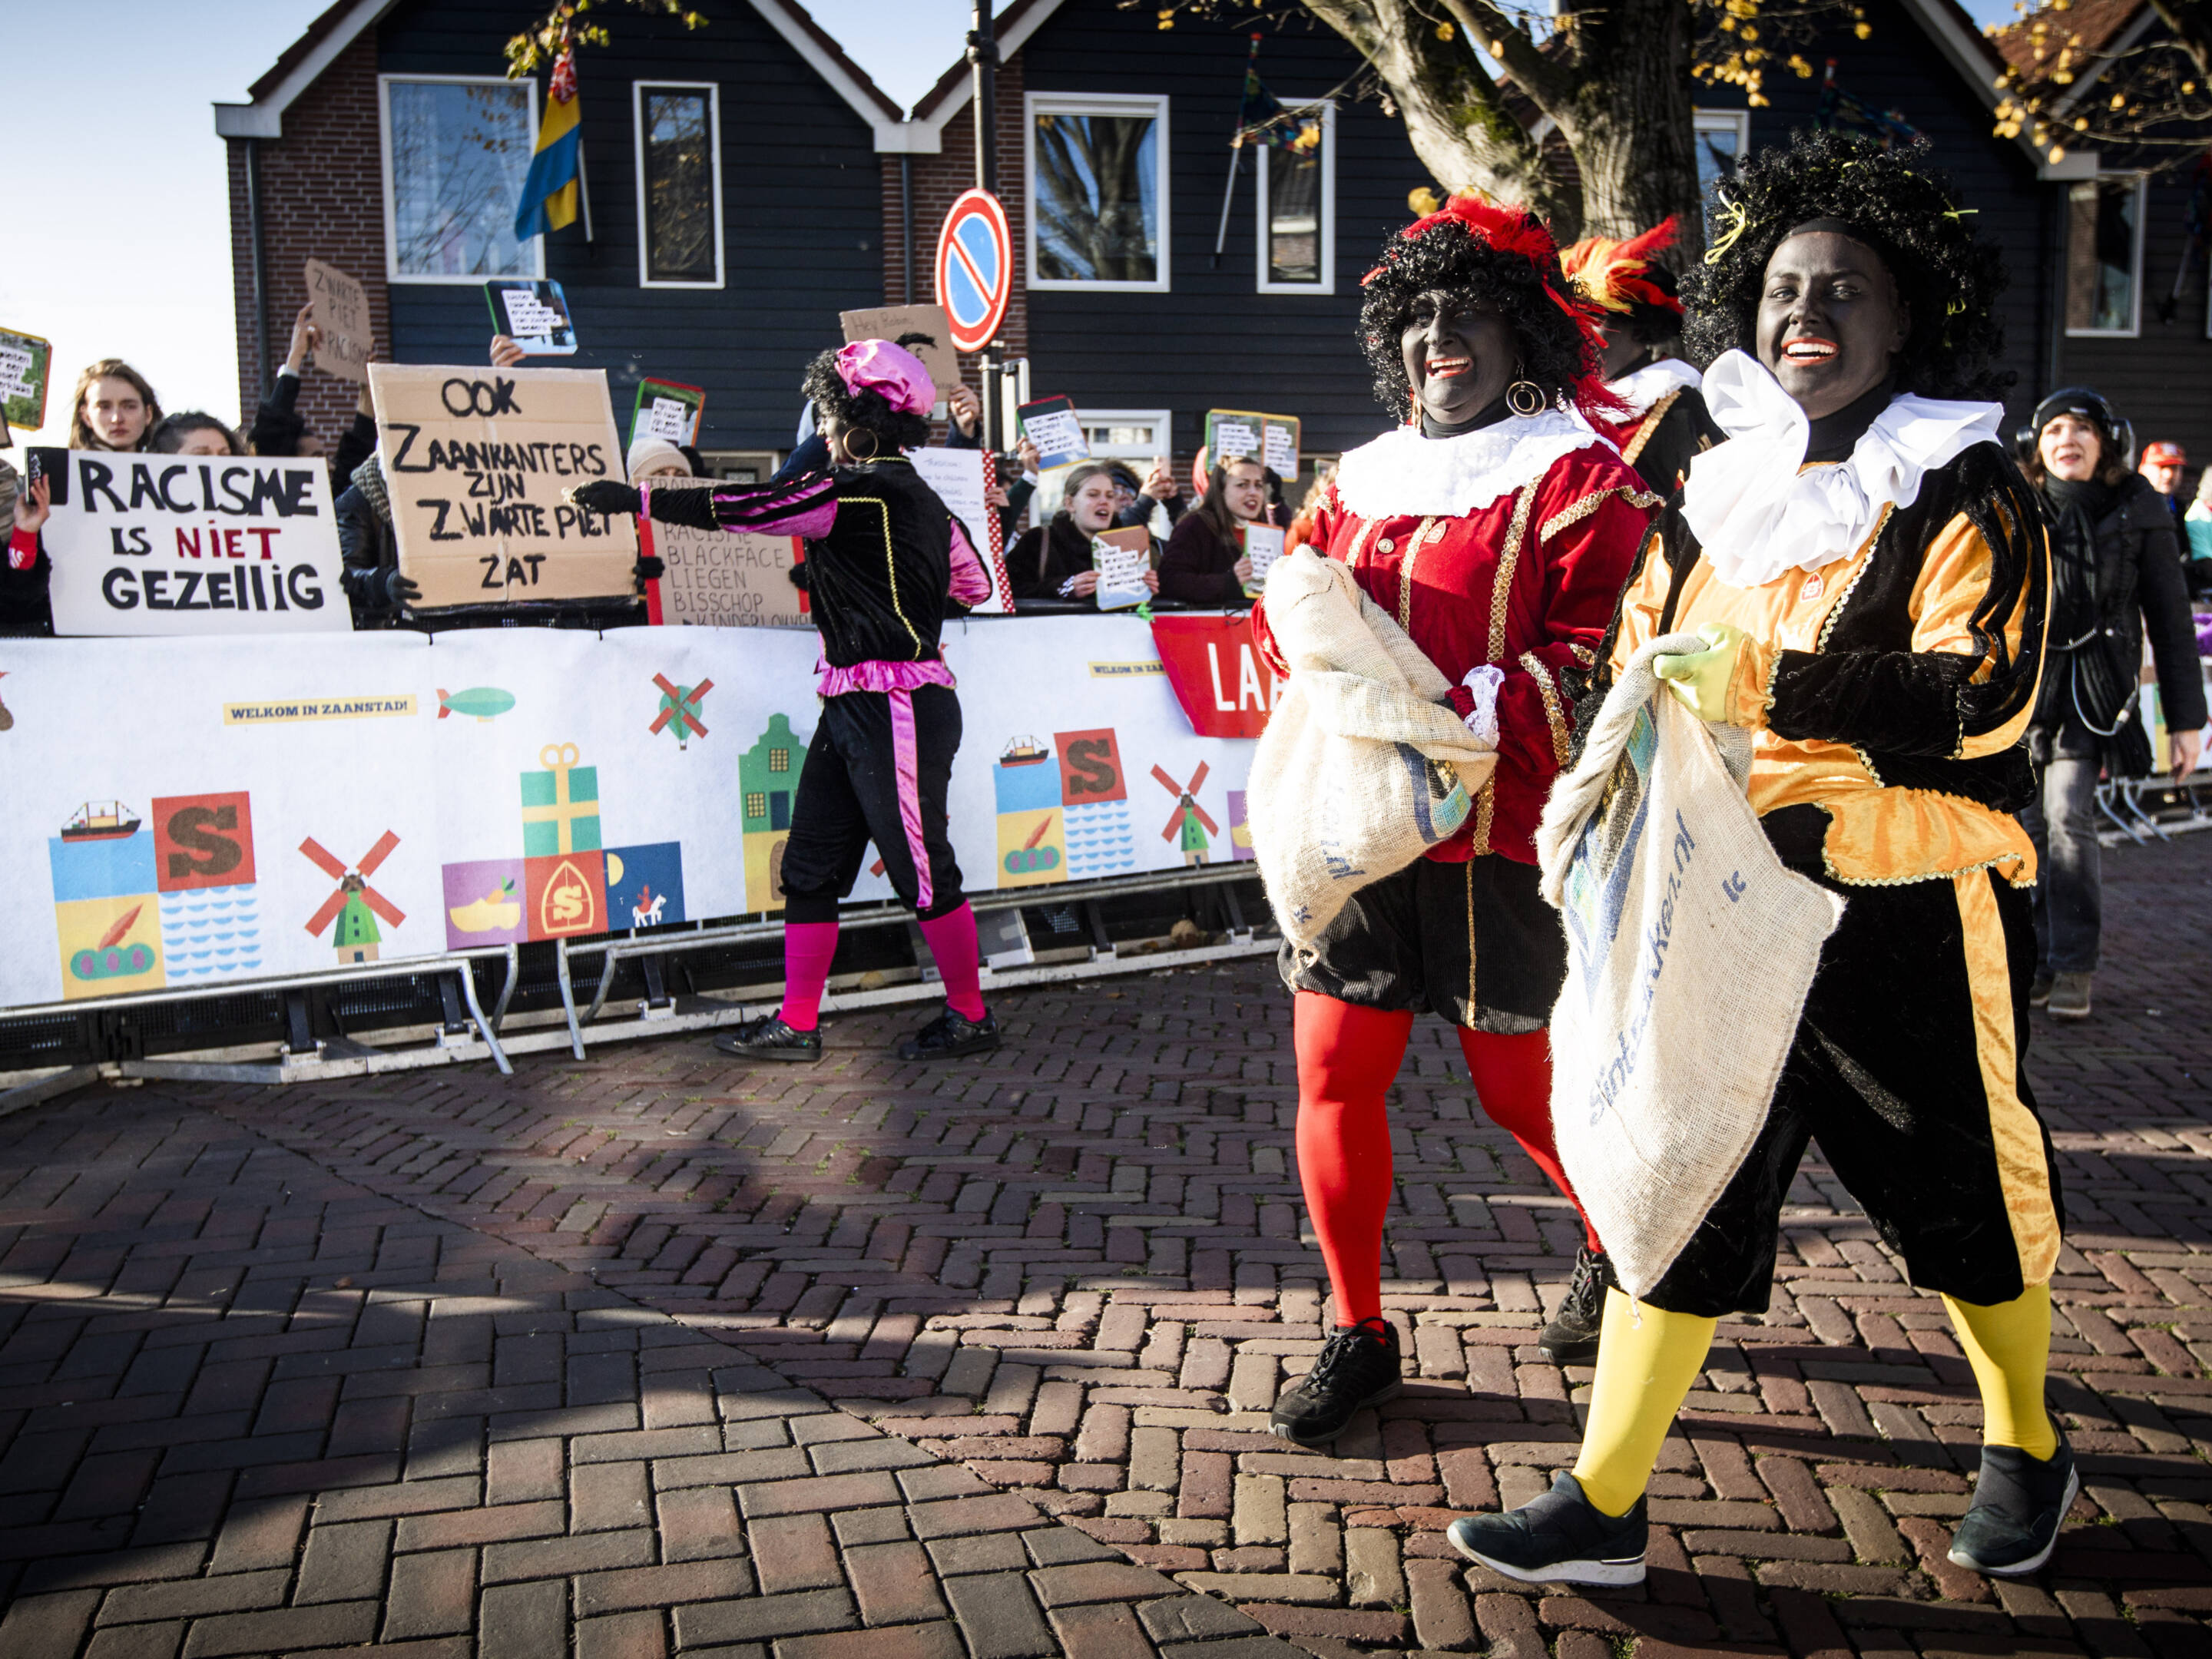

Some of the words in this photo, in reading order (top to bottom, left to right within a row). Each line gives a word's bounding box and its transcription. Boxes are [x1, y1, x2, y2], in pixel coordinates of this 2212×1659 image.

[442, 376, 522, 418] OOK
[386, 422, 607, 476] ZAANKANTERS
[78, 459, 319, 518] RACISME
[463, 471, 525, 505] ZIJN
[416, 498, 551, 541] ZWARTE
[110, 527, 153, 556] IS
[667, 545, 786, 569] BLACKFACE
[478, 554, 547, 589] ZAT
[670, 568, 747, 590] LIEGEN
[673, 591, 763, 613] BISSCHOP
[1094, 666, 1131, 674] WELKOM
[231, 706, 298, 720] WELKOM
[303, 704, 317, 715] IN
[322, 700, 407, 715] ZAANSTAD!
[1066, 738, 1116, 795] S
[167, 804, 243, 879] S
